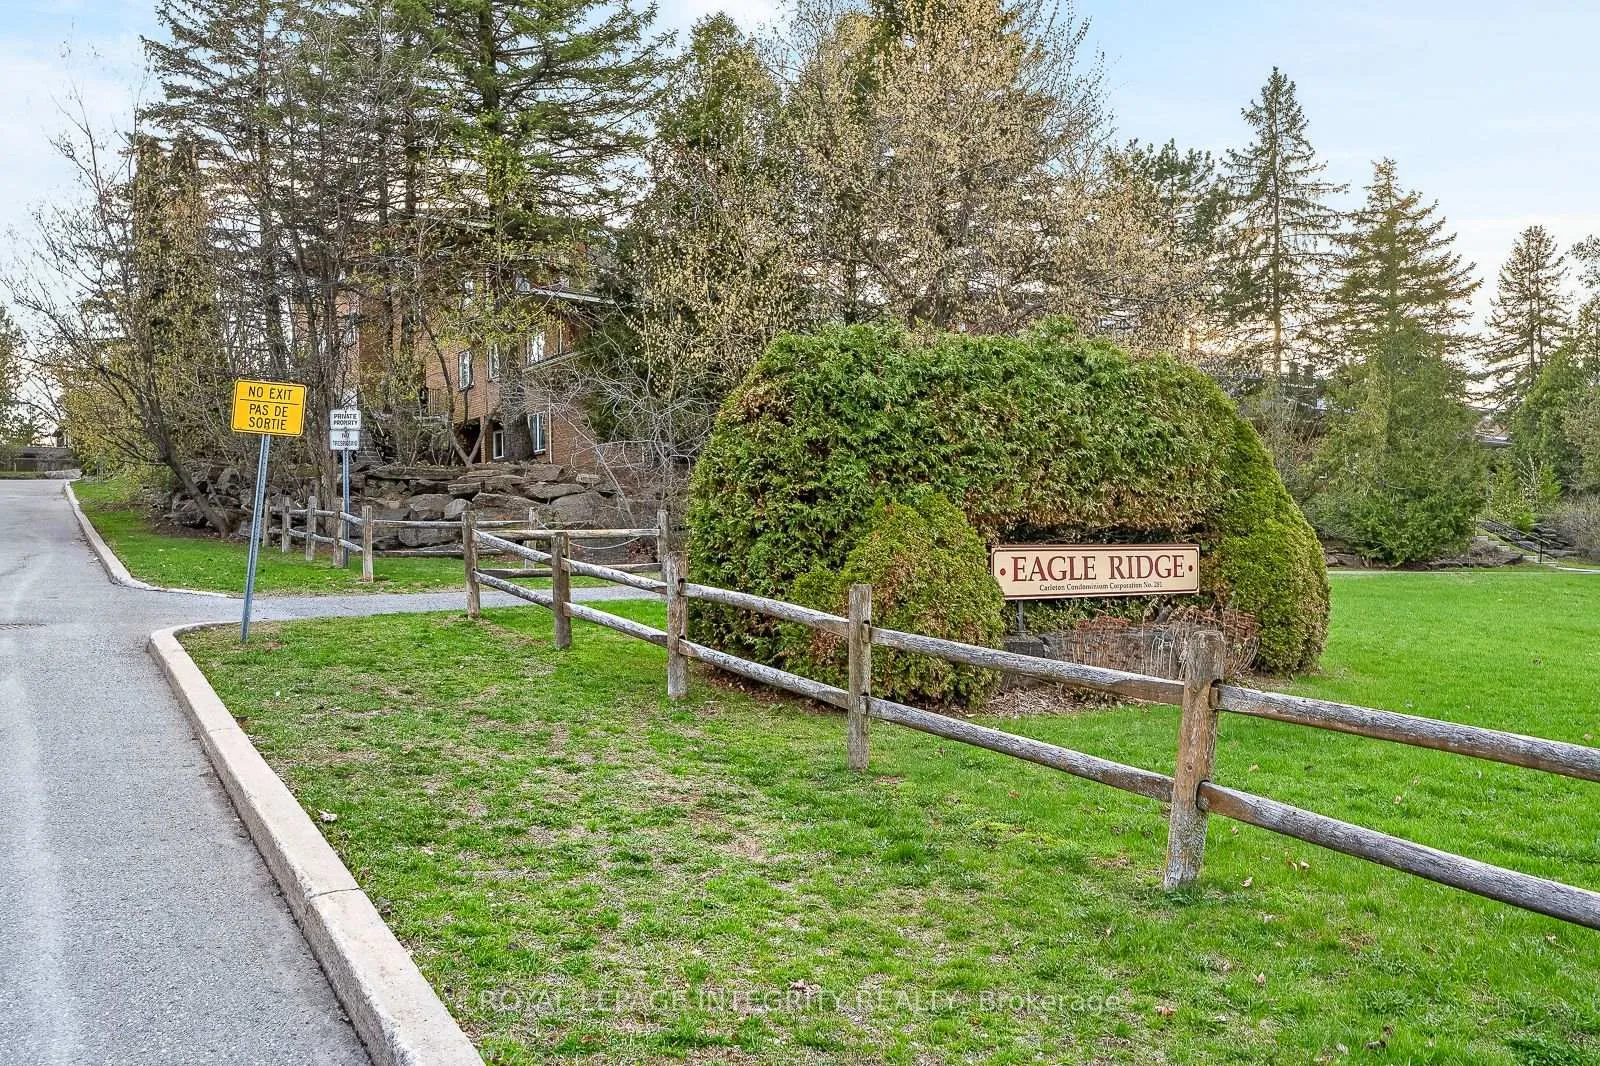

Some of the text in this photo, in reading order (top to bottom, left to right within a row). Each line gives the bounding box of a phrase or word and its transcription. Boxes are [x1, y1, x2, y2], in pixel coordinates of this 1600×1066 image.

[249, 386, 292, 400] NO EXIT
[249, 403, 288, 418] PAS DE
[249, 416, 287, 431] SORTIE
[1011, 554, 1185, 582] EAGLE RIDGE
[1066, 582, 1109, 591] Condominium
[1109, 581, 1143, 590] Corporation
